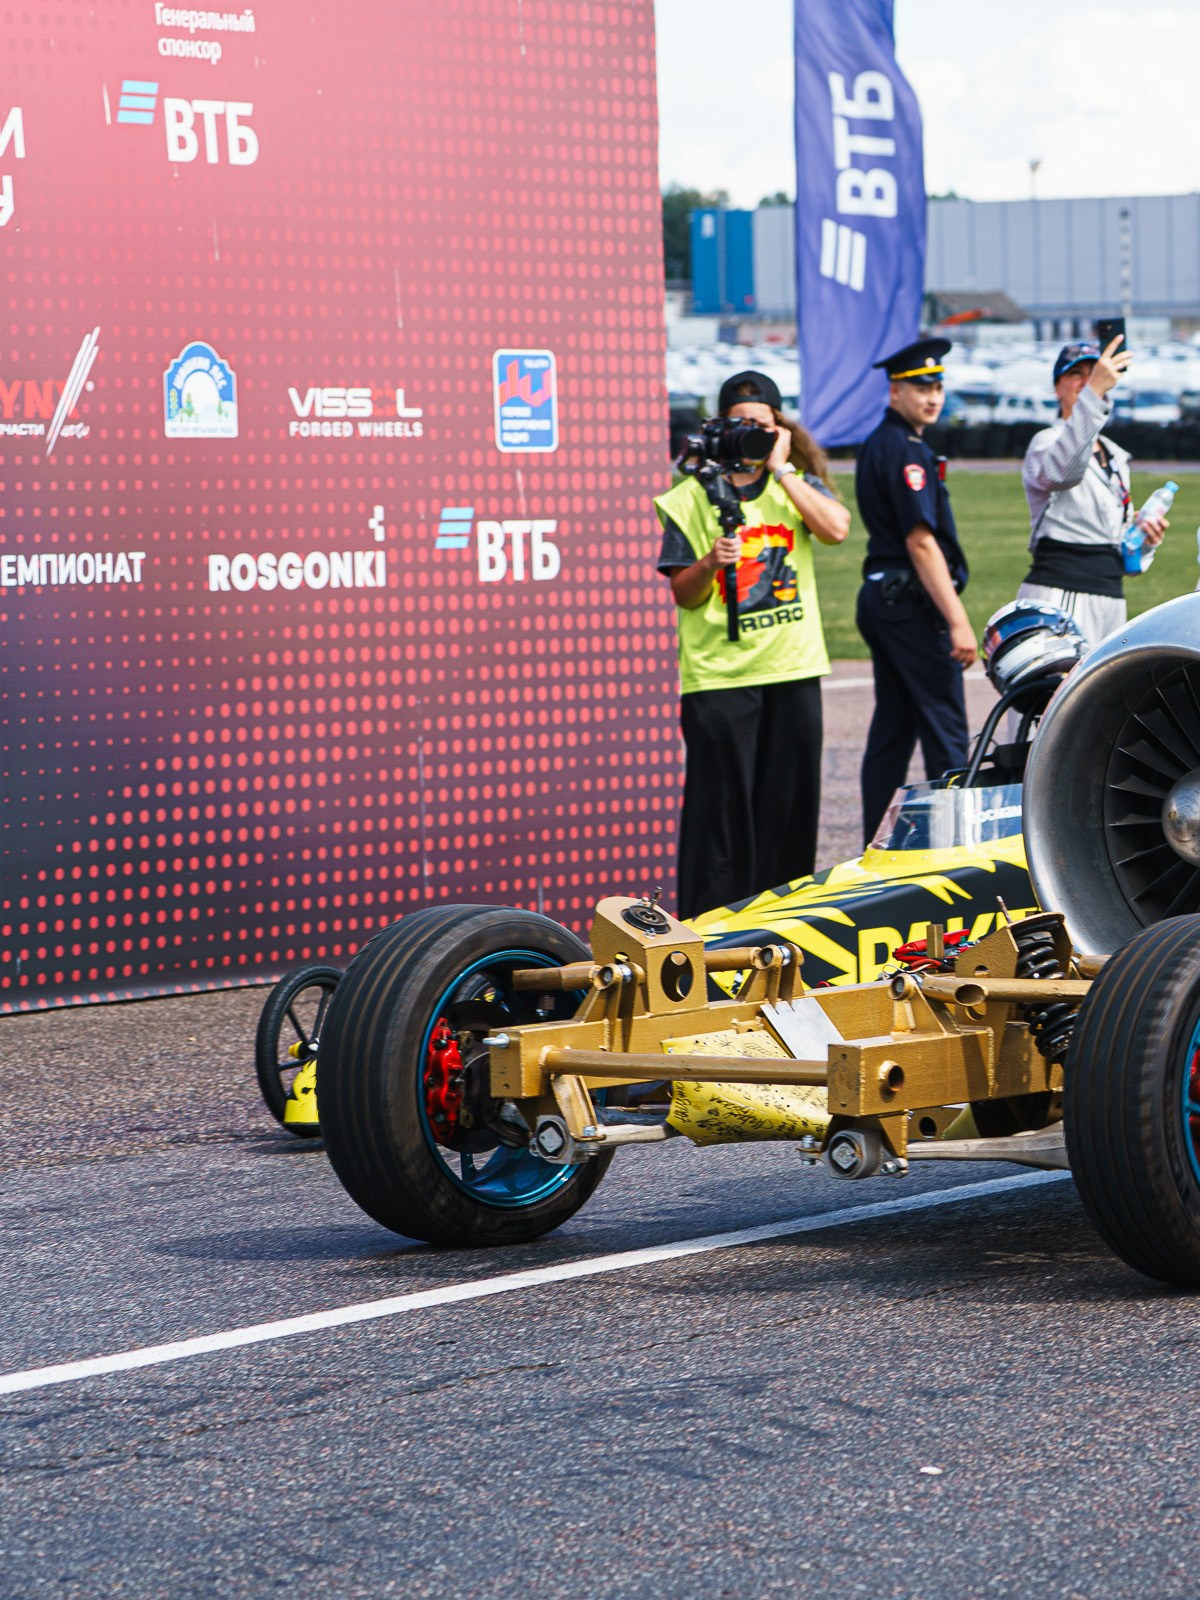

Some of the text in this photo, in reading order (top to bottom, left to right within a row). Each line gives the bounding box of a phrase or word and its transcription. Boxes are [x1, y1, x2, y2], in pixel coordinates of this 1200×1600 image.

[154, 2, 256, 34] Генеральный
[157, 37, 222, 65] спонсор
[163, 97, 259, 166] ВТБ
[828, 70, 898, 218] ВТБ
[287, 386, 424, 418] VISSOL
[288, 420, 424, 437] FORGED WHEELS
[476, 519, 561, 582] ВТБ
[0, 551, 147, 586] ЕМПИОНАТ
[208, 551, 387, 592] ROSGONKI
[740, 606, 804, 633] RDRC
